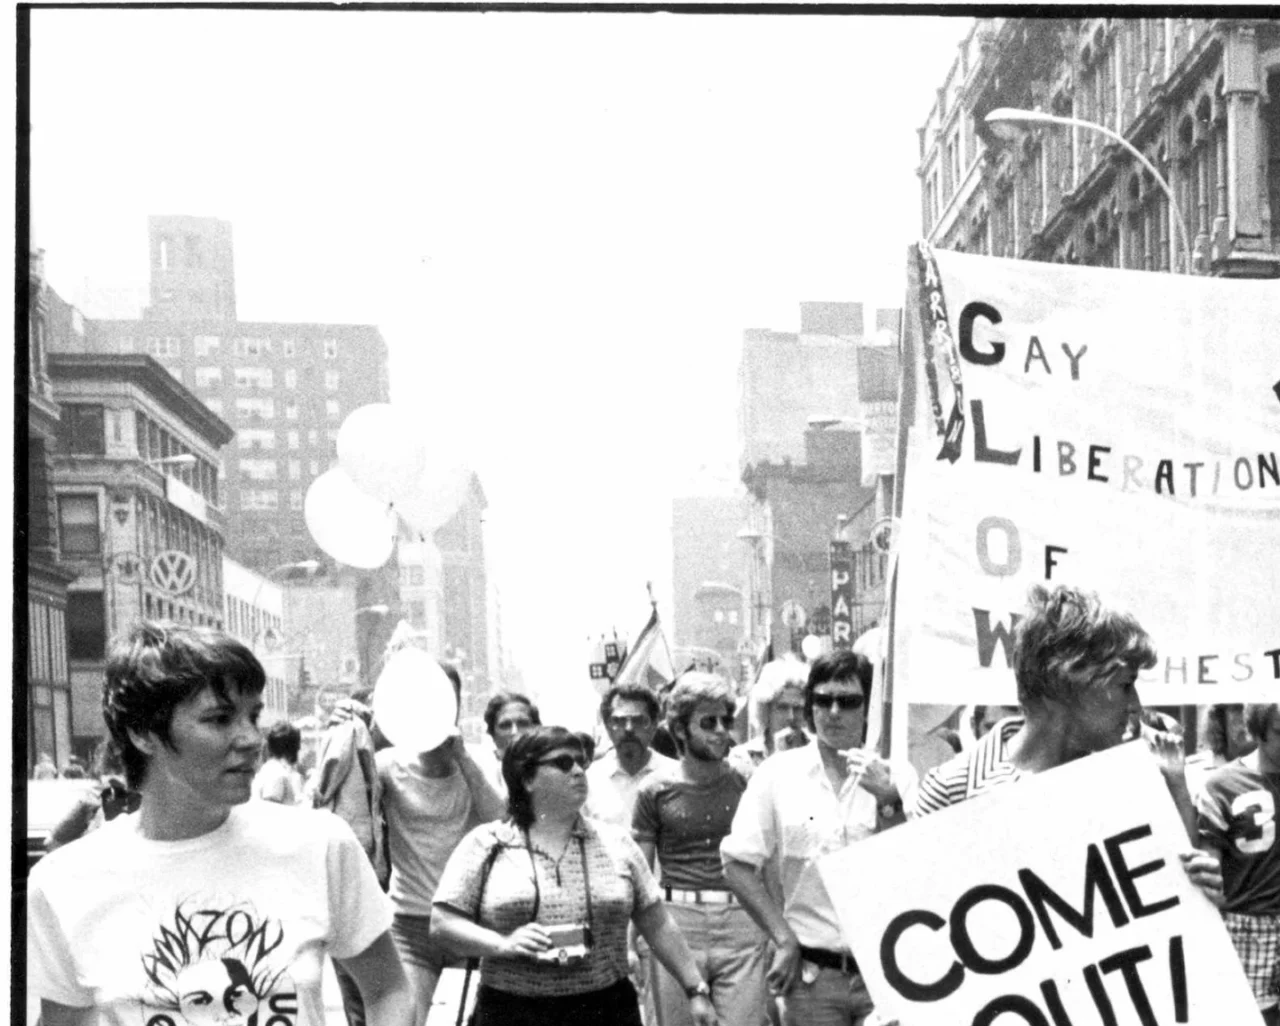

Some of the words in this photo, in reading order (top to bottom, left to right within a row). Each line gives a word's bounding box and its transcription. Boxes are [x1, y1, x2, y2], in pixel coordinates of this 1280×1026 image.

[958, 302, 1088, 381] GAY
[976, 516, 1068, 579] OF
[880, 824, 1181, 1002] COME
